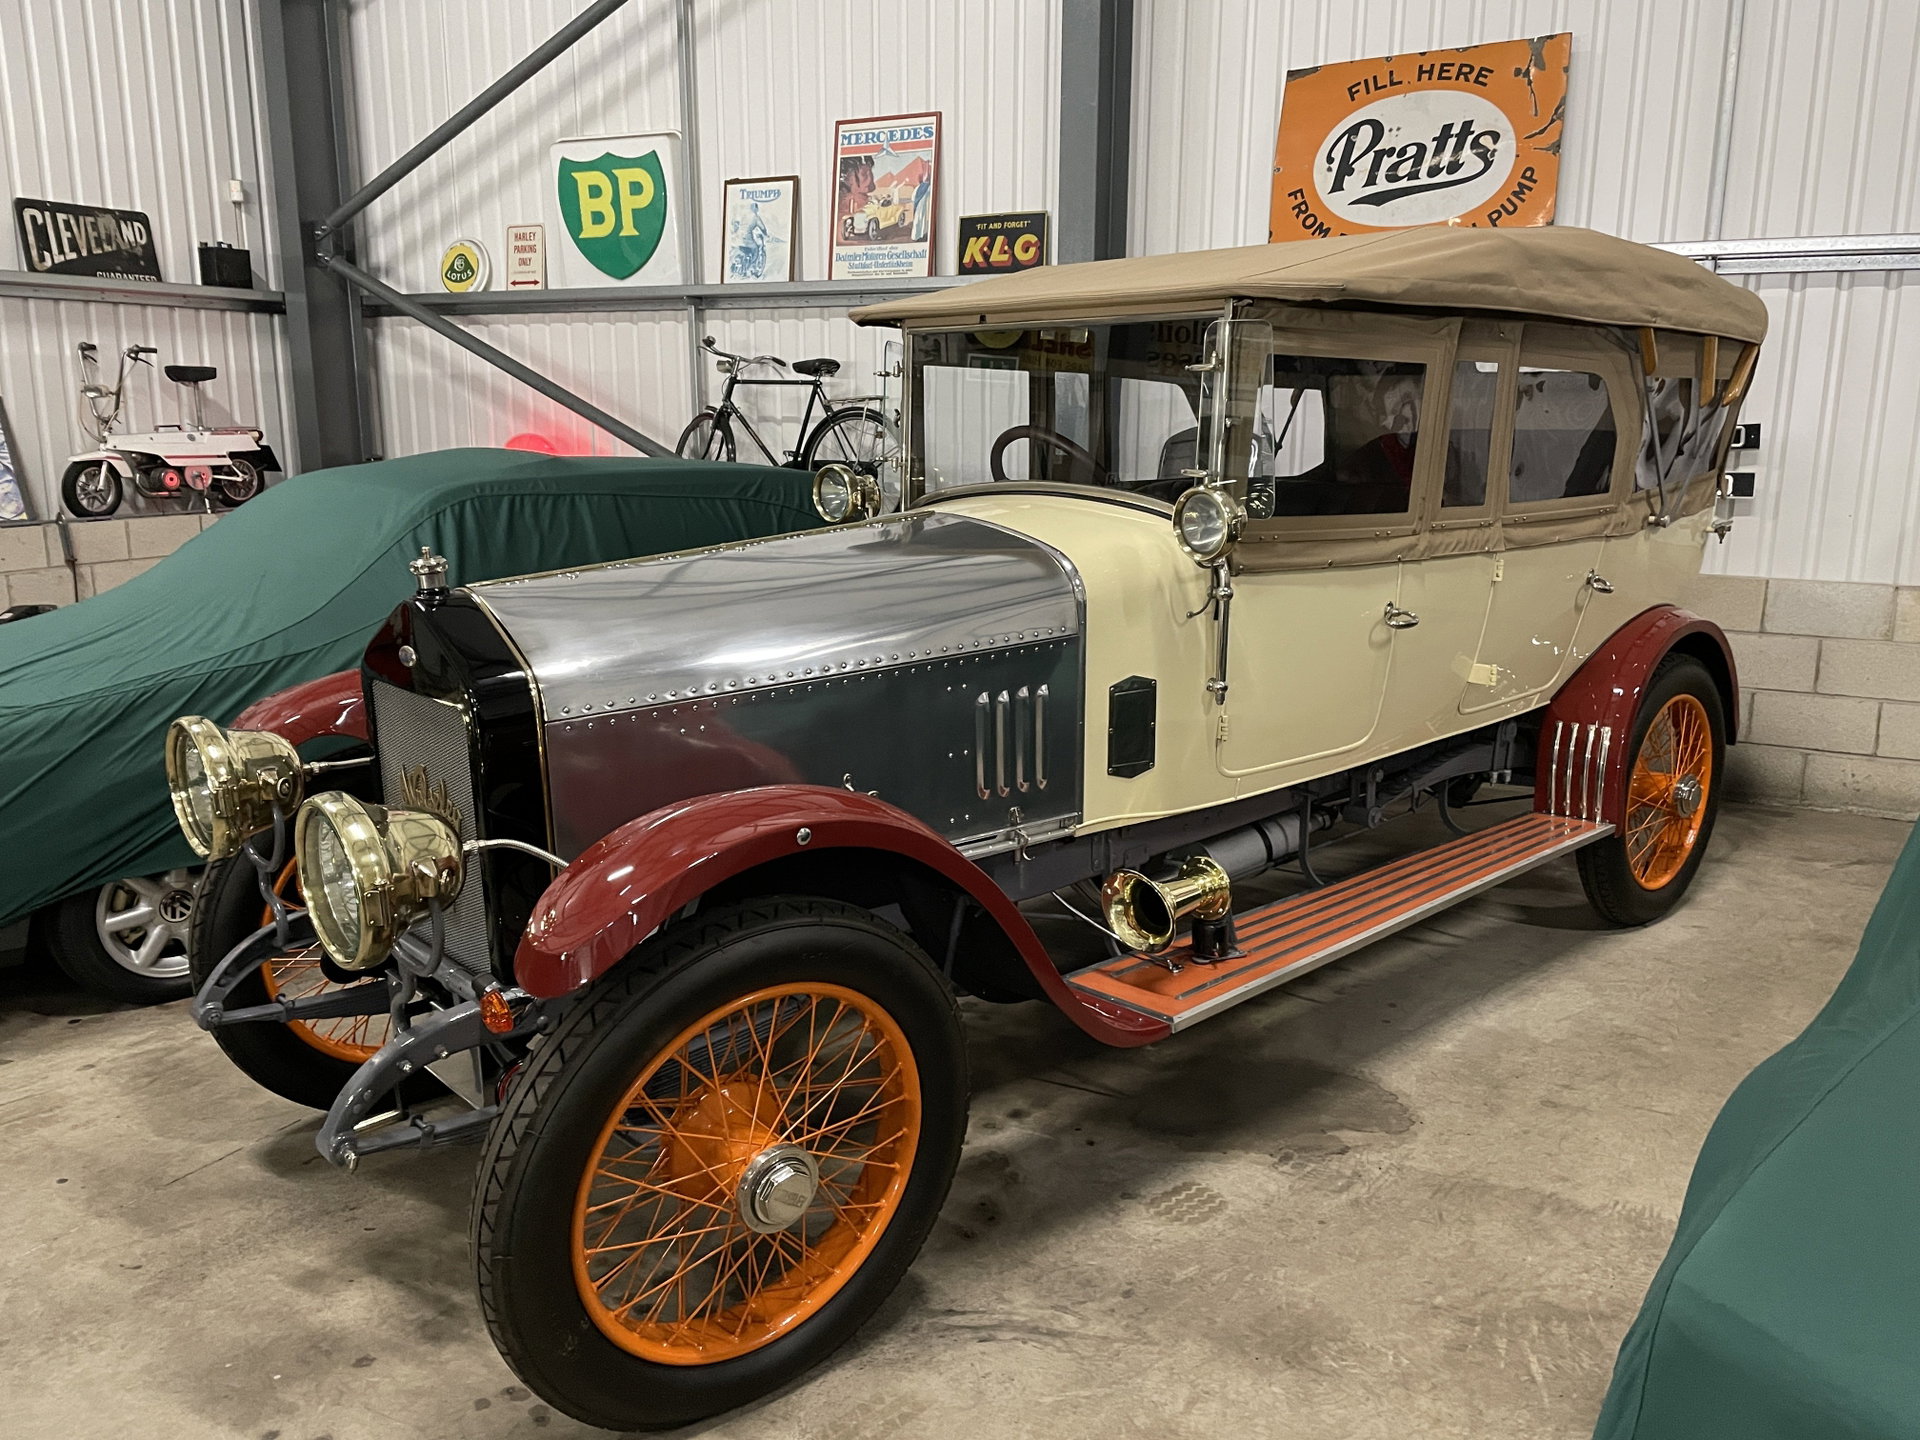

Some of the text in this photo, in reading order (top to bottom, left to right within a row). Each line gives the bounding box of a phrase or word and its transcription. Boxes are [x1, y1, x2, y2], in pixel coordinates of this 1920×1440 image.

[1347, 62, 1494, 102] FILL HERE
[840, 125, 934, 146] MERCEDES
[1325, 118, 1501, 206] Pratts
[570, 167, 655, 239] BP
[740, 188, 781, 202] TRIUMPH
[1287, 166, 1538, 238] FROM PUMP
[988, 221, 1002, 230] AND
[22, 207, 148, 271] CLEVELAND
[514, 231, 537, 242] HARLEY
[513, 244, 537, 254] PARKING
[518, 257, 532, 267] ONLY
[446, 269, 473, 281] LOTUS
